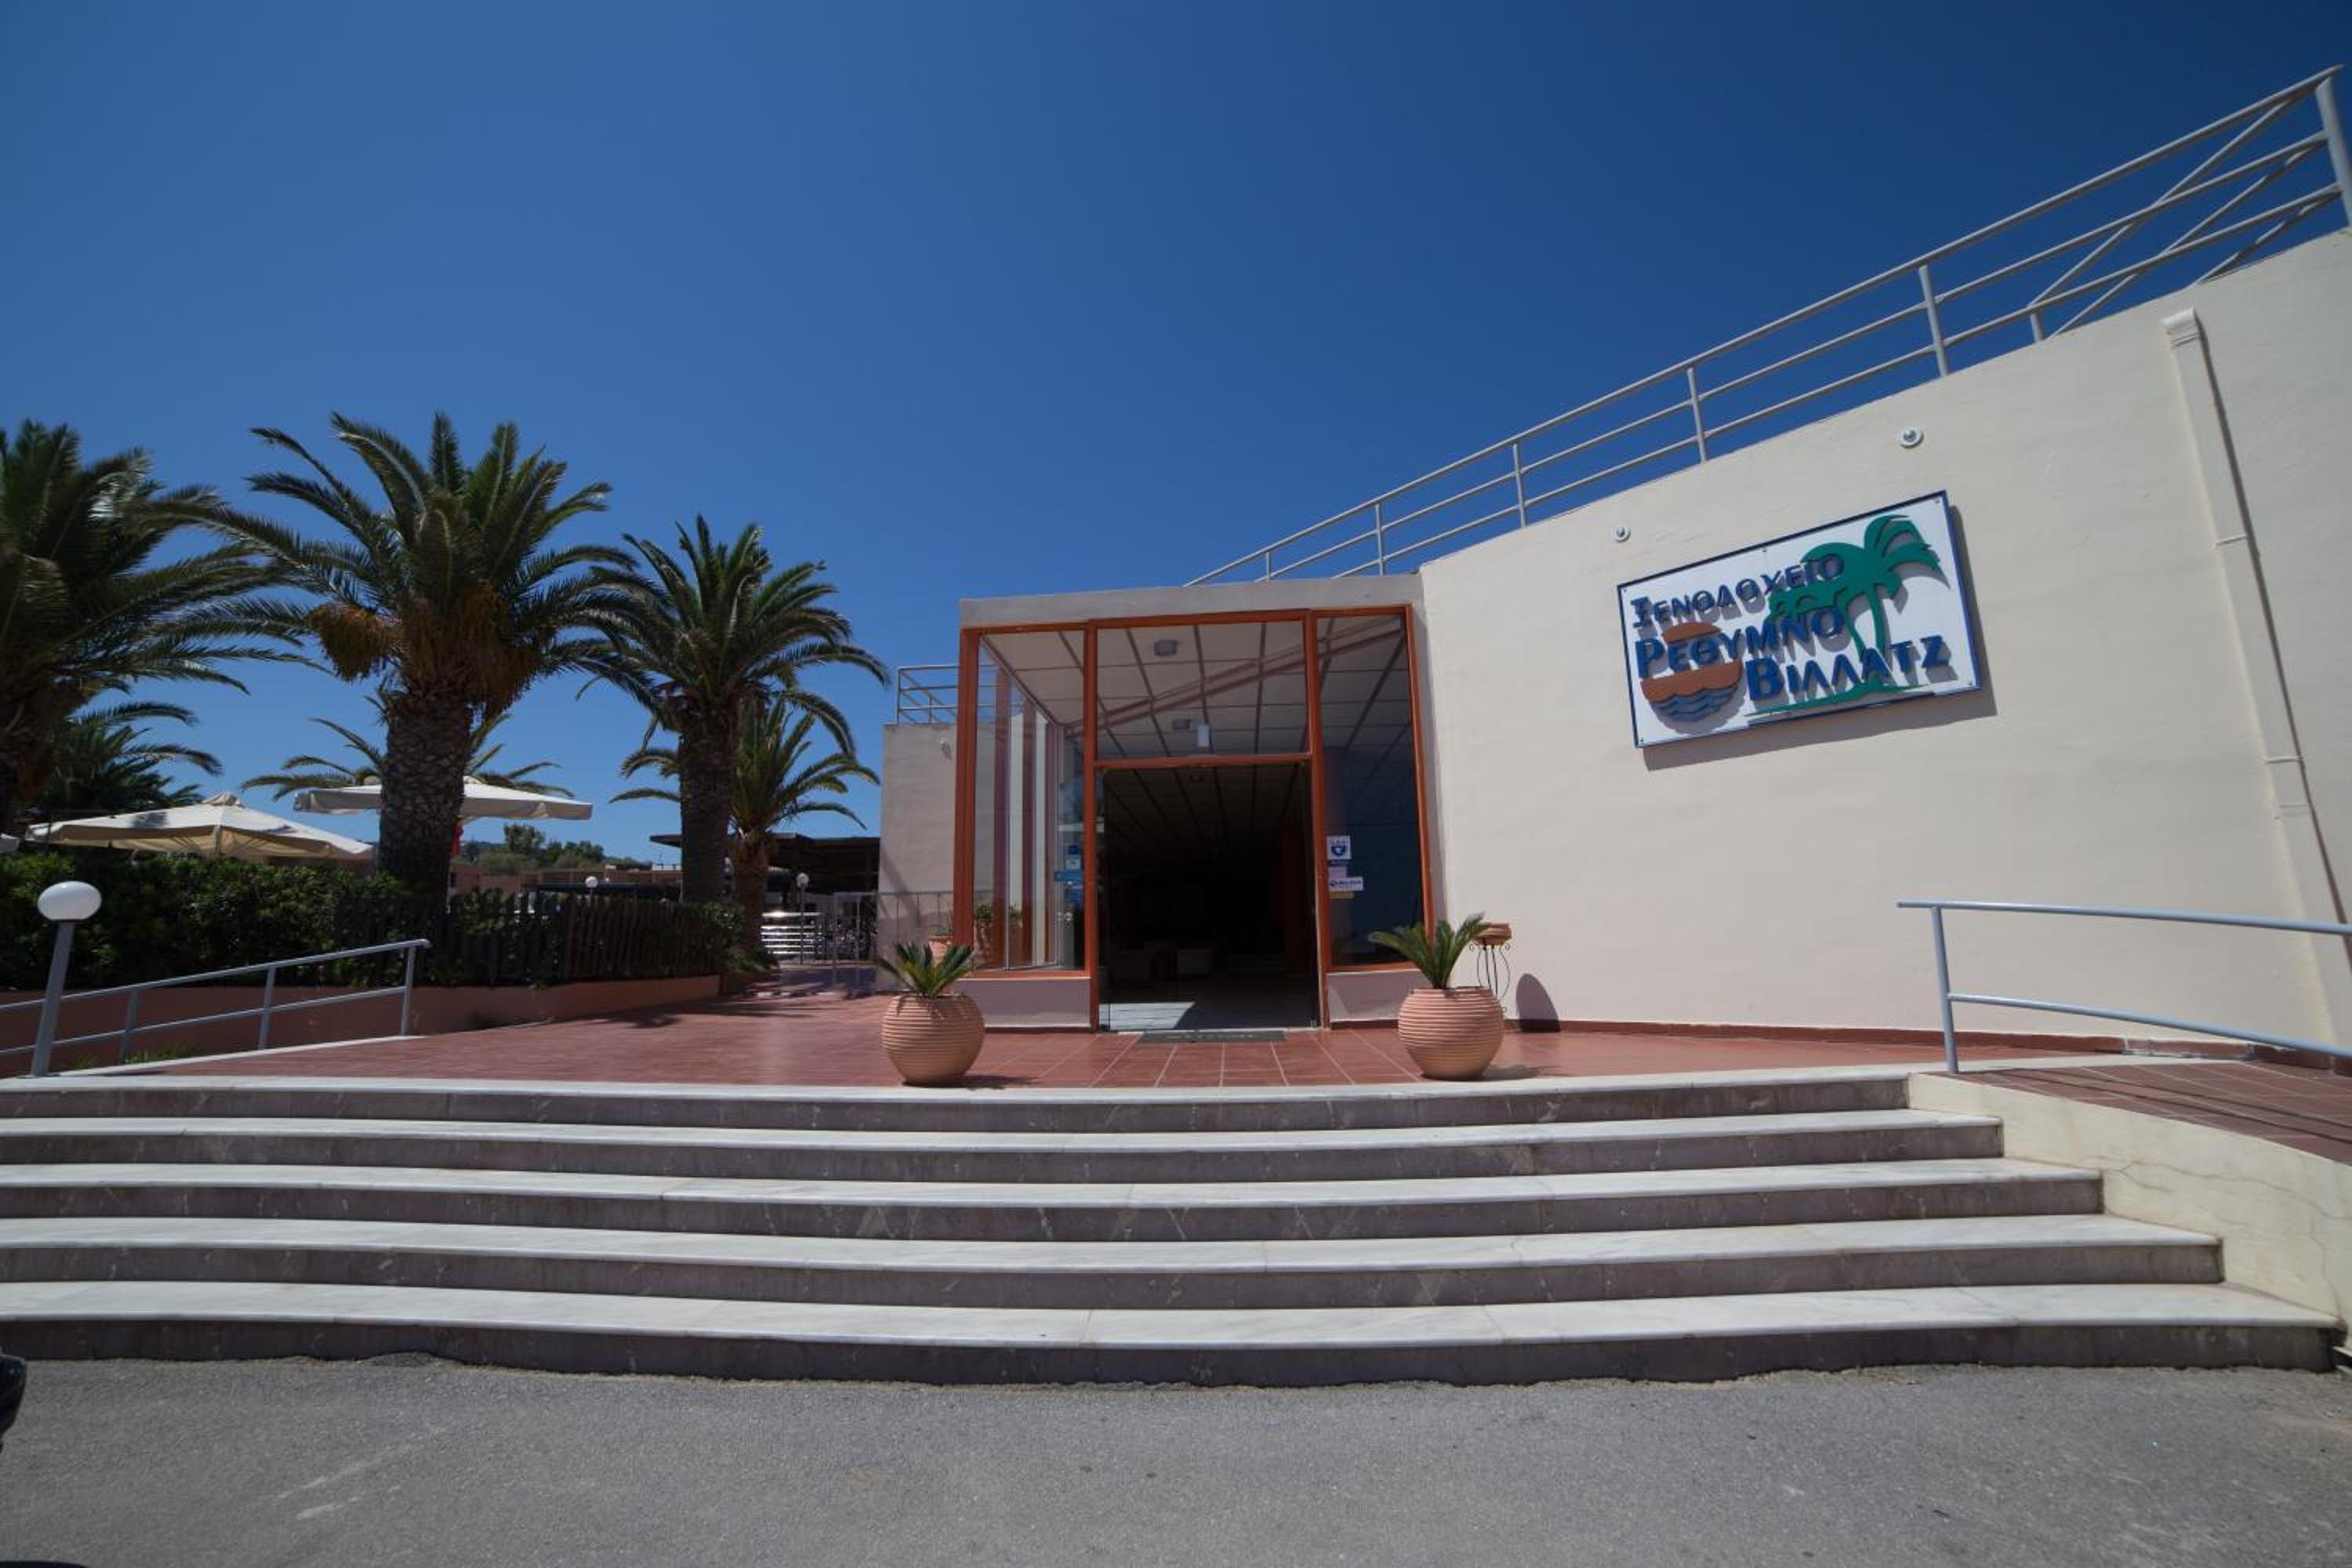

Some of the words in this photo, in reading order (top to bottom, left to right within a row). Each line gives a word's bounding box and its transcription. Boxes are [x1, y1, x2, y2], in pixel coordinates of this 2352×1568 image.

[1630, 553, 1845, 628] ΞΕΝΟΔΟΧΕΙΟ
[1635, 607, 1845, 679] ΡΕΘΥΜΝΟ
[1745, 635, 1950, 701] ΒΙΛΛΑΤΖ
